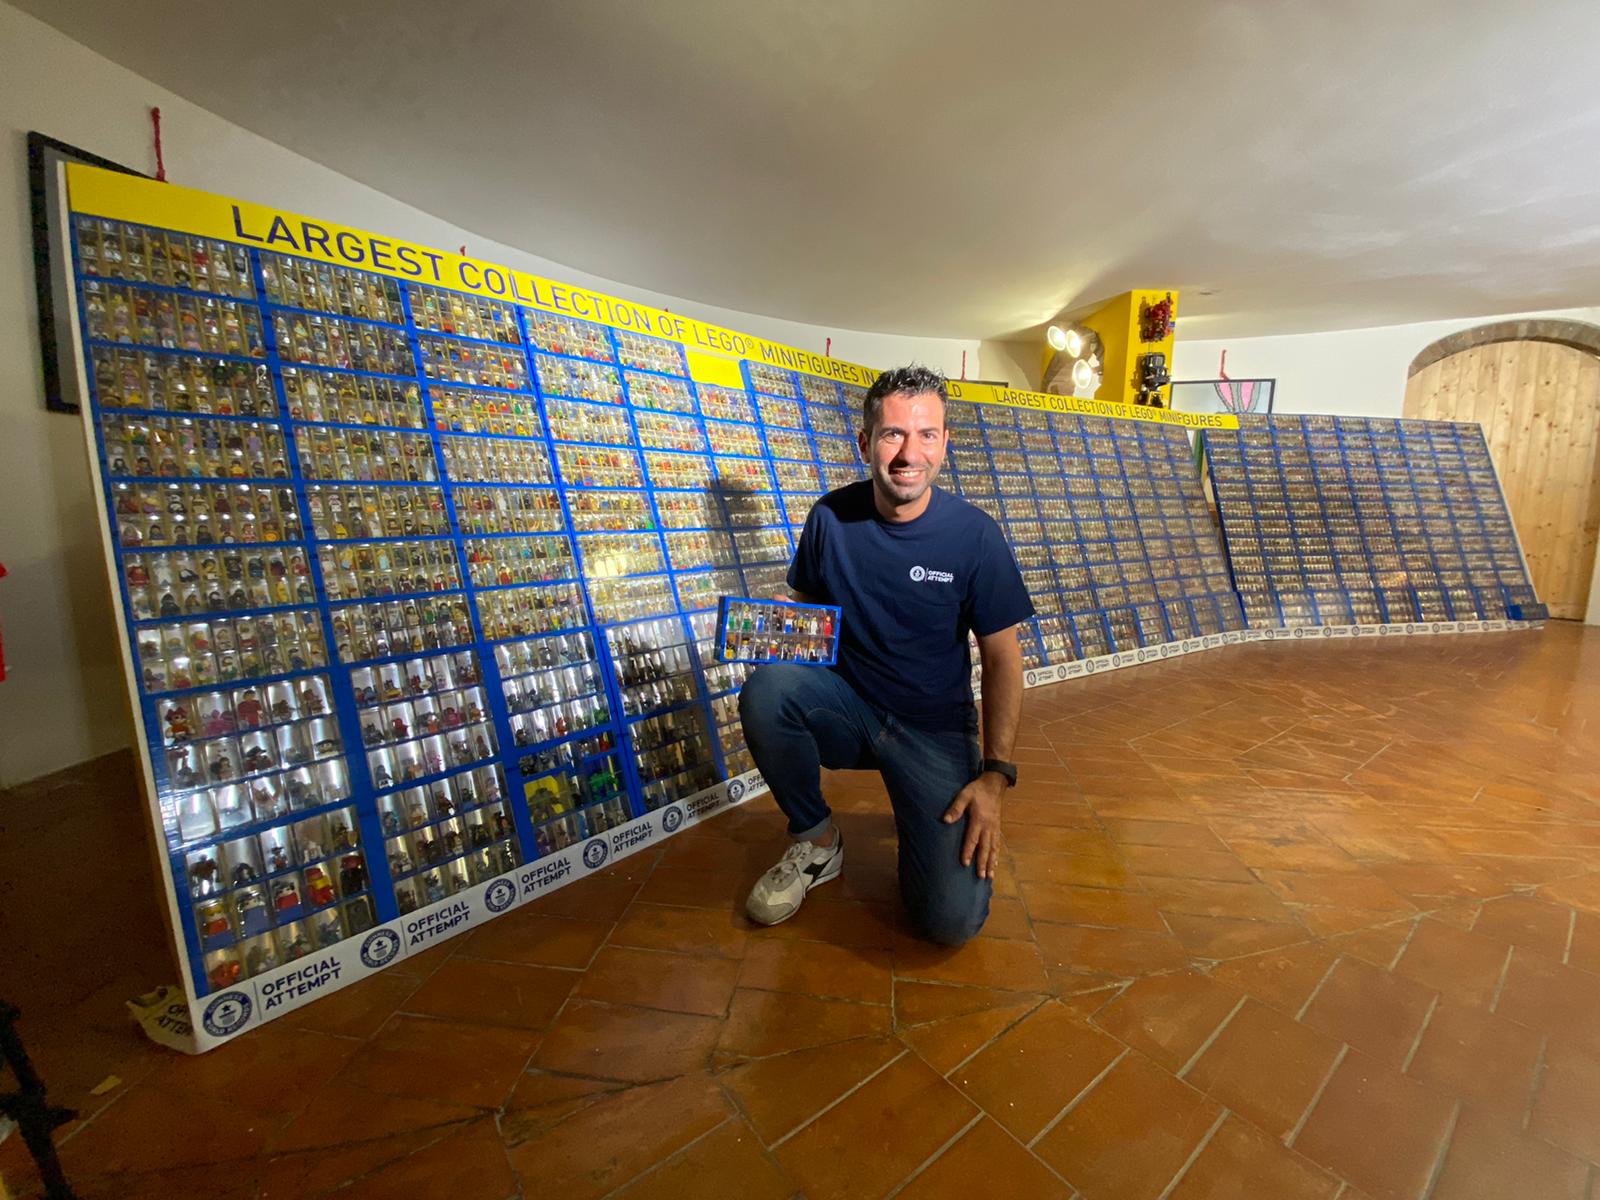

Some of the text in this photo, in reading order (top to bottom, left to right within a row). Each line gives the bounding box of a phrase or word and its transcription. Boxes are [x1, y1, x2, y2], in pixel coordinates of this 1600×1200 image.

[231, 205, 443, 281] LARGEST
[458, 262, 652, 332] COLLECTION
[658, 315, 685, 339] OF
[692, 323, 754, 355] LEGO®
[760, 342, 860, 382] MINIFIGURES
[861, 368, 876, 386] IN
[996, 387, 1047, 410] LARGEST
[1050, 398, 1113, 416] COLLECTION
[1115, 405, 1127, 417] OF
[928, 570, 953, 578] OFFICIAL
[687, 792, 719, 811] OFFICIAL
[687, 800, 720, 820] ATTEMPT
[612, 822, 653, 844] OFFICIAL
[613, 829, 654, 854] ATTEMPT
[521, 857, 571, 884] OFFICIAL
[523, 866, 572, 895] ATTEMPT
[407, 901, 470, 933] OFFICIAL
[410, 911, 471, 946] ATTEMPT
[261, 957, 340, 996] OFFICIAL
[265, 967, 342, 1010] ATTEMPT
